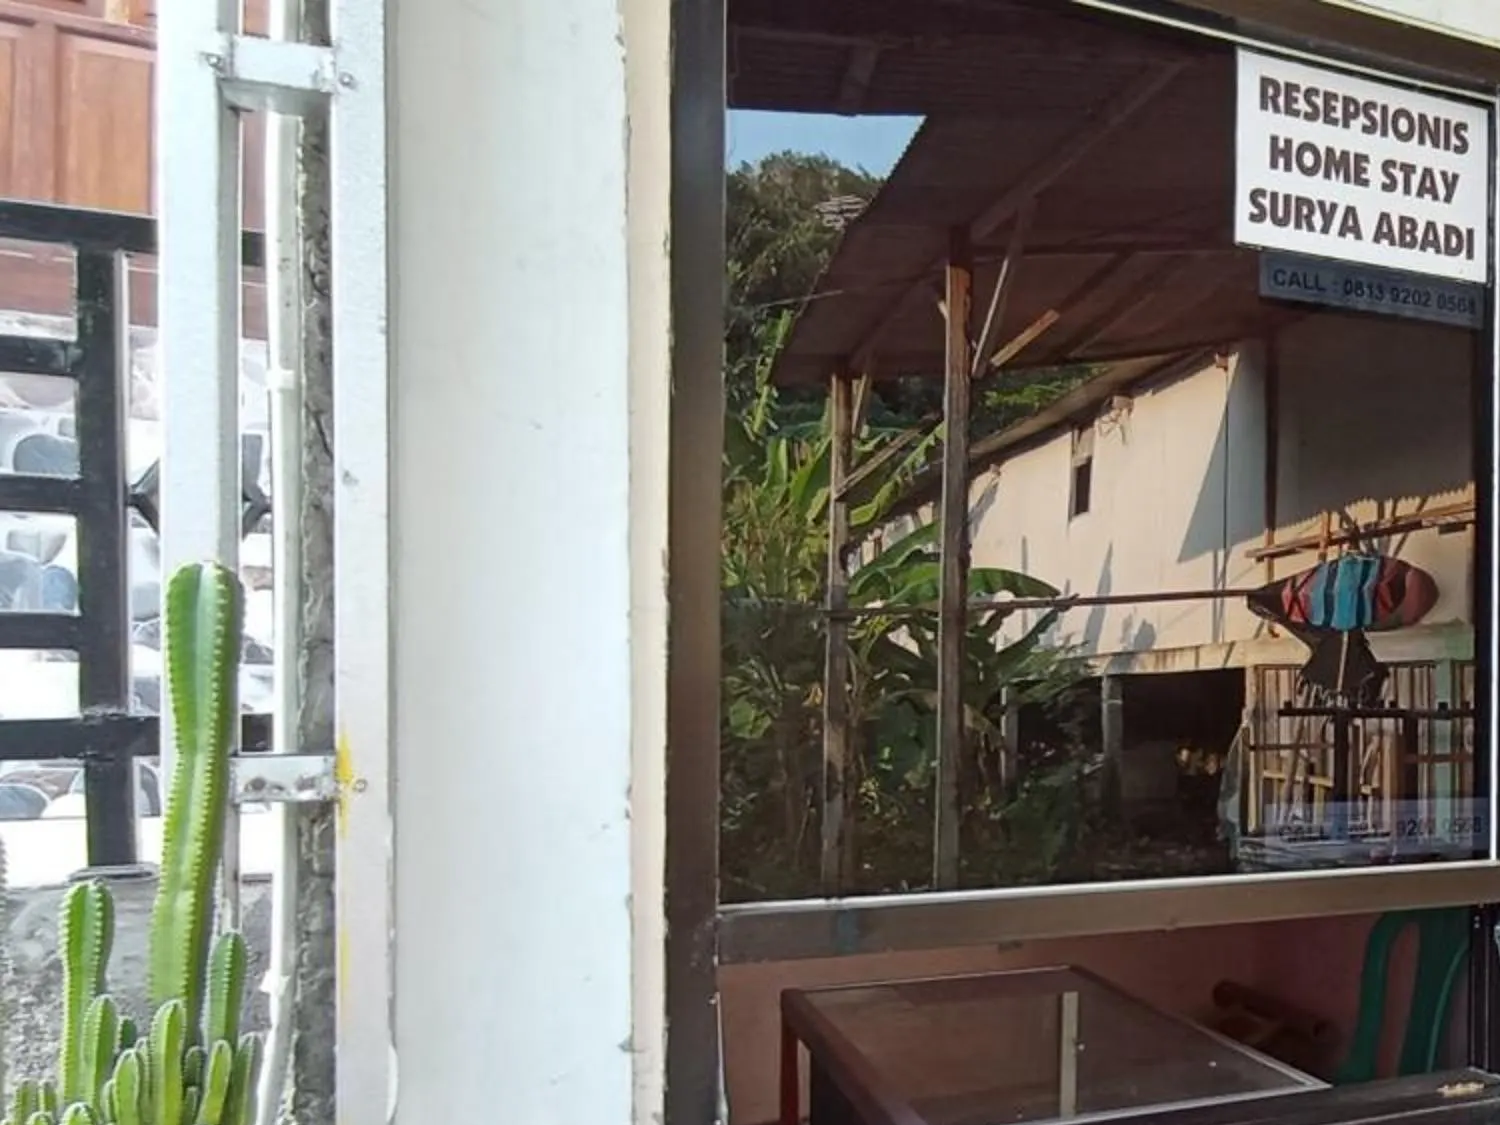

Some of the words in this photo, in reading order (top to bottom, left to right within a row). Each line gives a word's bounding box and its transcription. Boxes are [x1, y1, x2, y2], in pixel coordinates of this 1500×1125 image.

[1259, 75, 1470, 155] RESEPSIONIS
[1269, 134, 1371, 188] HOME
[1380, 158, 1461, 205] STAY
[1248, 187, 1363, 241] SURYA
[1372, 211, 1476, 261] ABADI
[1272, 268, 1326, 292] CALL
[1343, 277, 1386, 301] 0813
[1390, 286, 1432, 308] 9202
